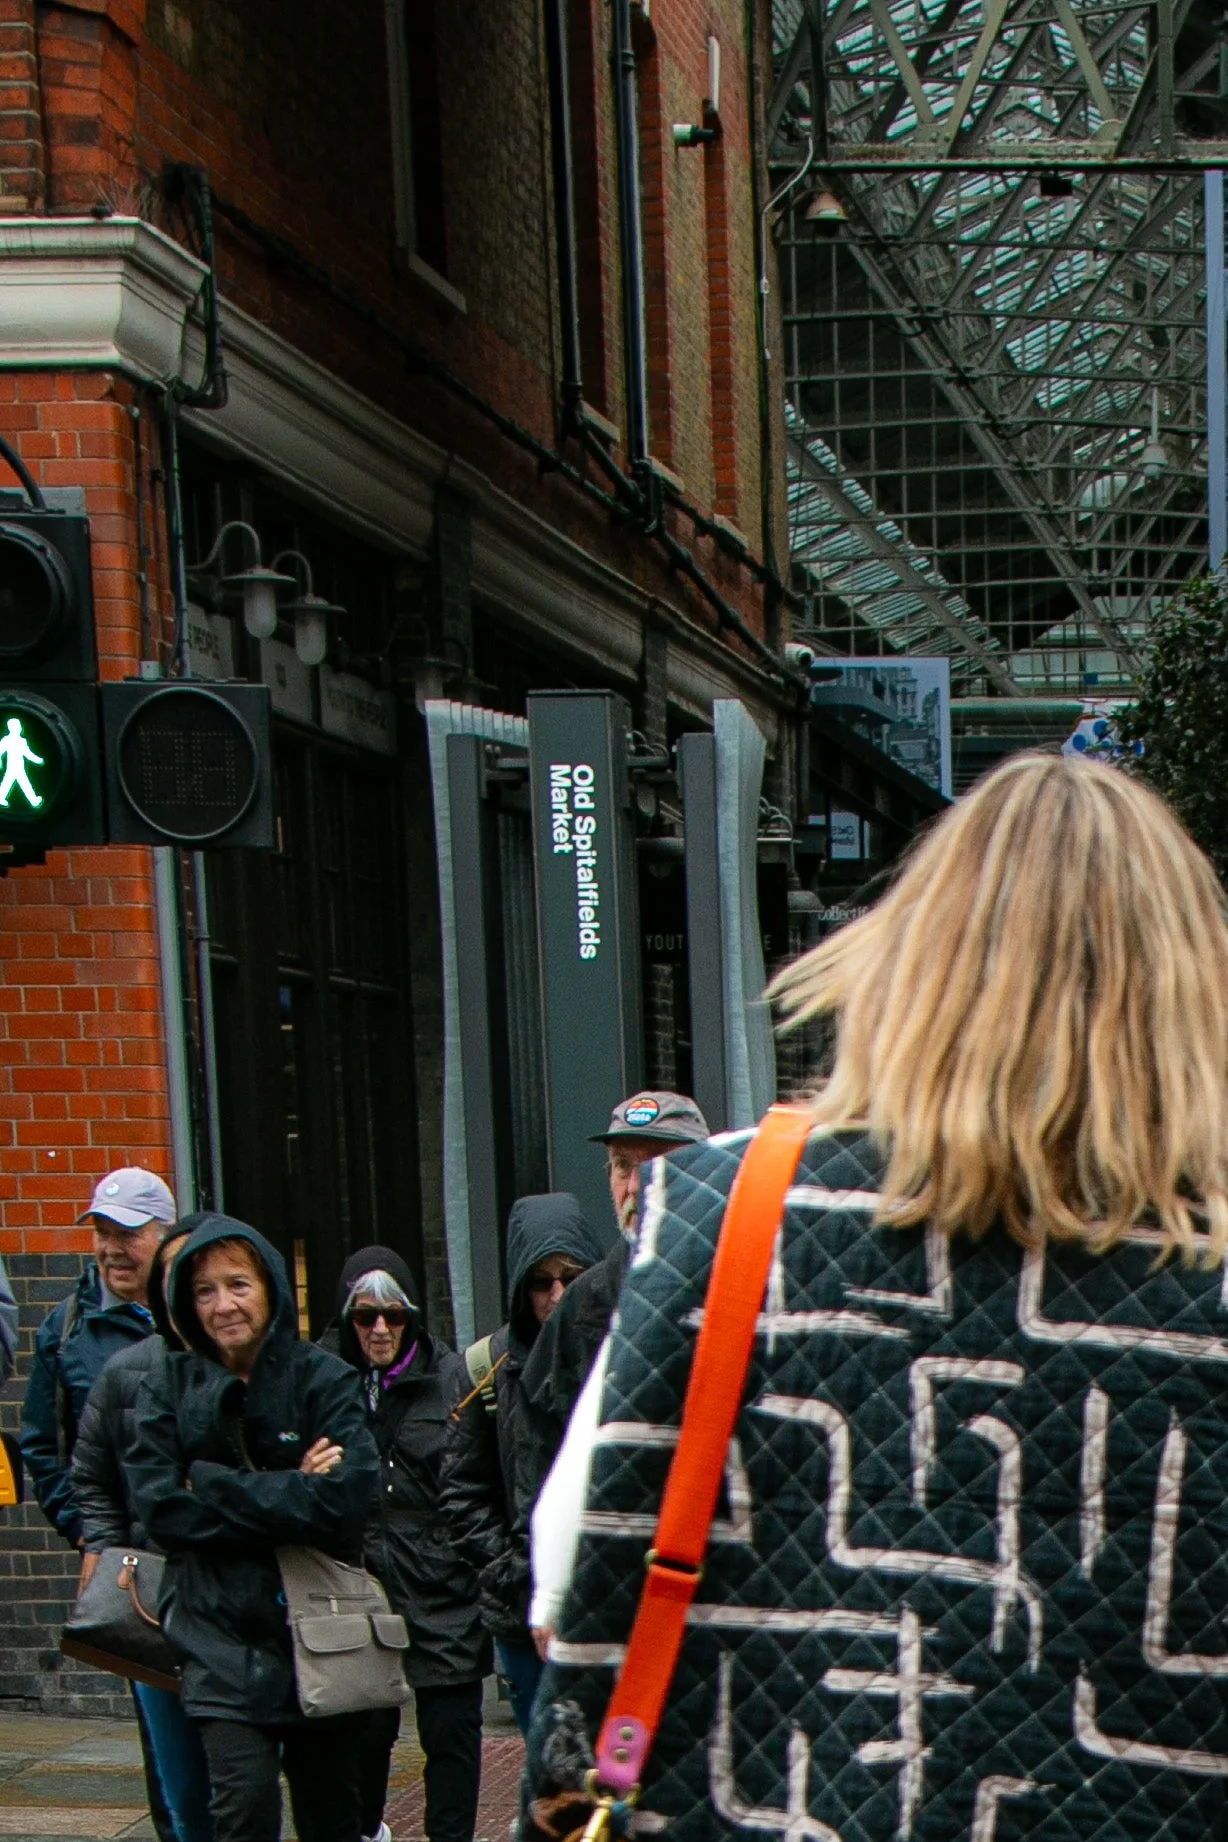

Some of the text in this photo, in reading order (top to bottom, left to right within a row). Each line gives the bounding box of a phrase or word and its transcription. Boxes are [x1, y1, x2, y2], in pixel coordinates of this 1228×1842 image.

[550, 764, 573, 854] Market
[572, 764, 600, 959] Old Spitalfields
[645, 935, 684, 950] YOUT
